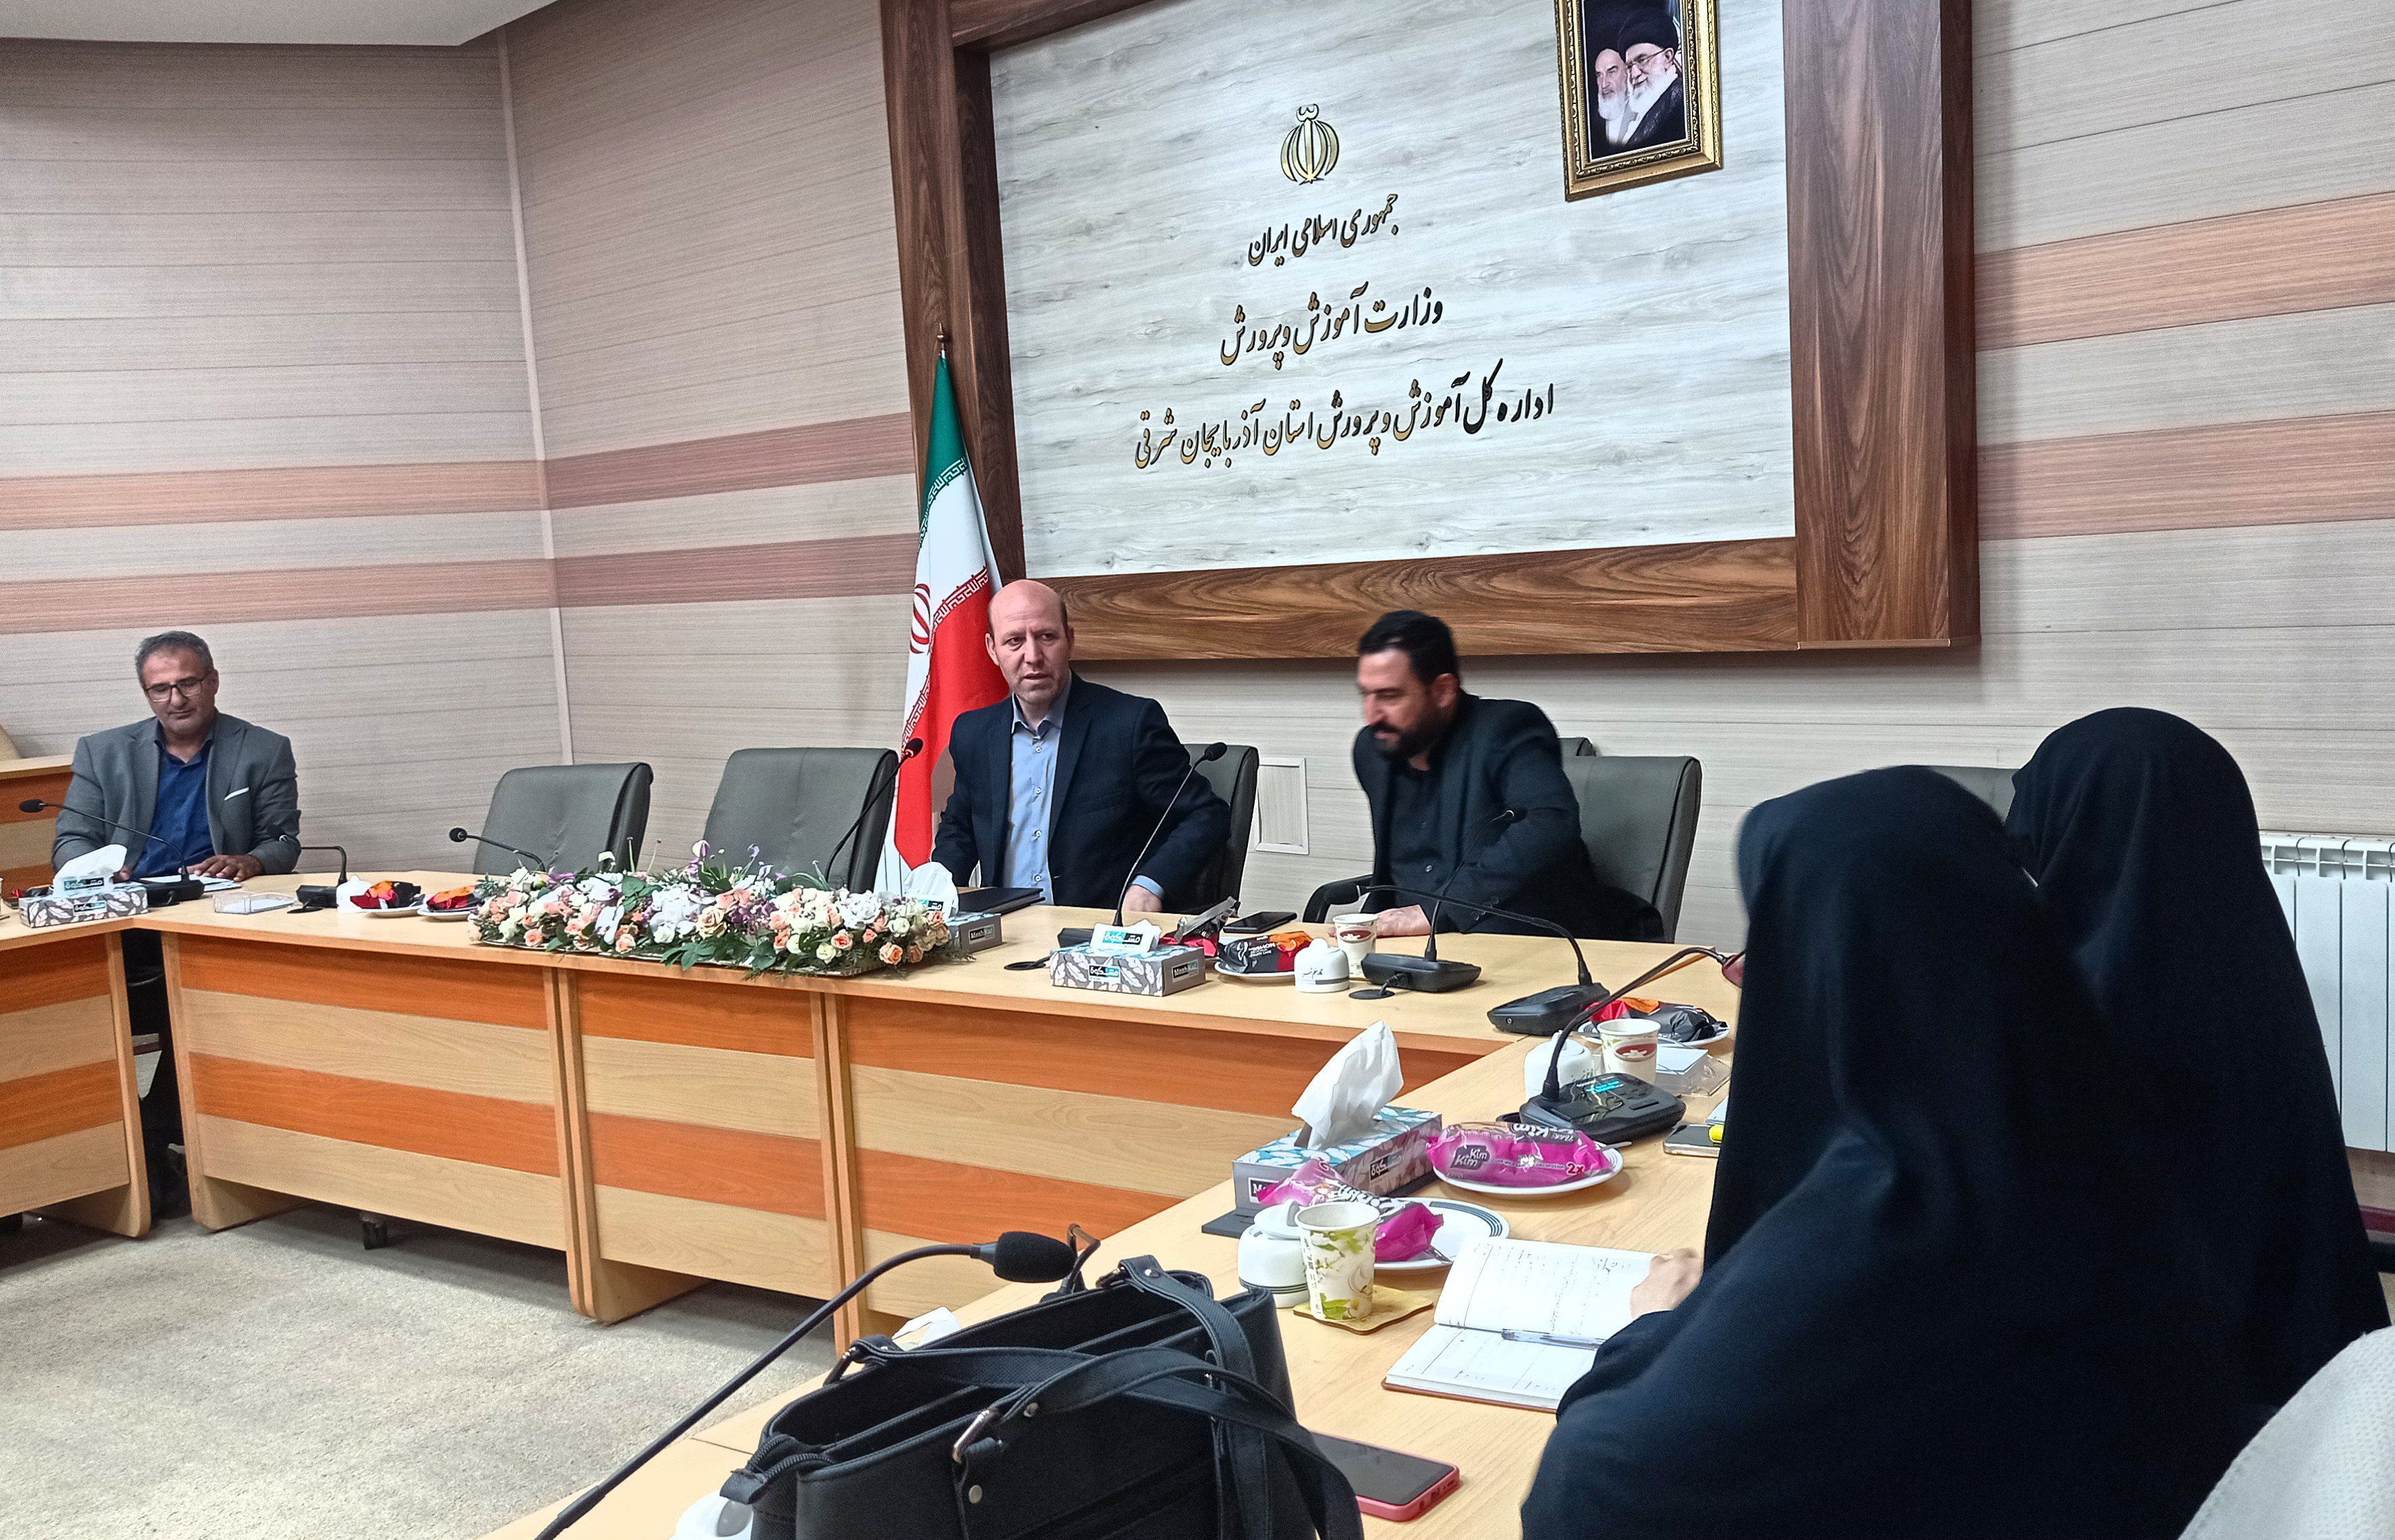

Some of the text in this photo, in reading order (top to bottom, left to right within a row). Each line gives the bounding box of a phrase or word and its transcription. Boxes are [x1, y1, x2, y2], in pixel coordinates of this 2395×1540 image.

[1248, 193, 1399, 268] جمهوری اسلامی ایران
[1292, 281, 1370, 356] آموزش
[1363, 286, 1444, 334] وزارت
[1262, 398, 1314, 457] استان
[1392, 370, 1471, 442] آموزش
[1463, 357, 1504, 435] کل
[1496, 383, 1554, 423] اداره
[1134, 407, 1178, 470] شرقی
[1180, 398, 1267, 469] آذربایجان
[1455, 1154, 1478, 1167] Kim
[1470, 1148, 1487, 1160] Kim
